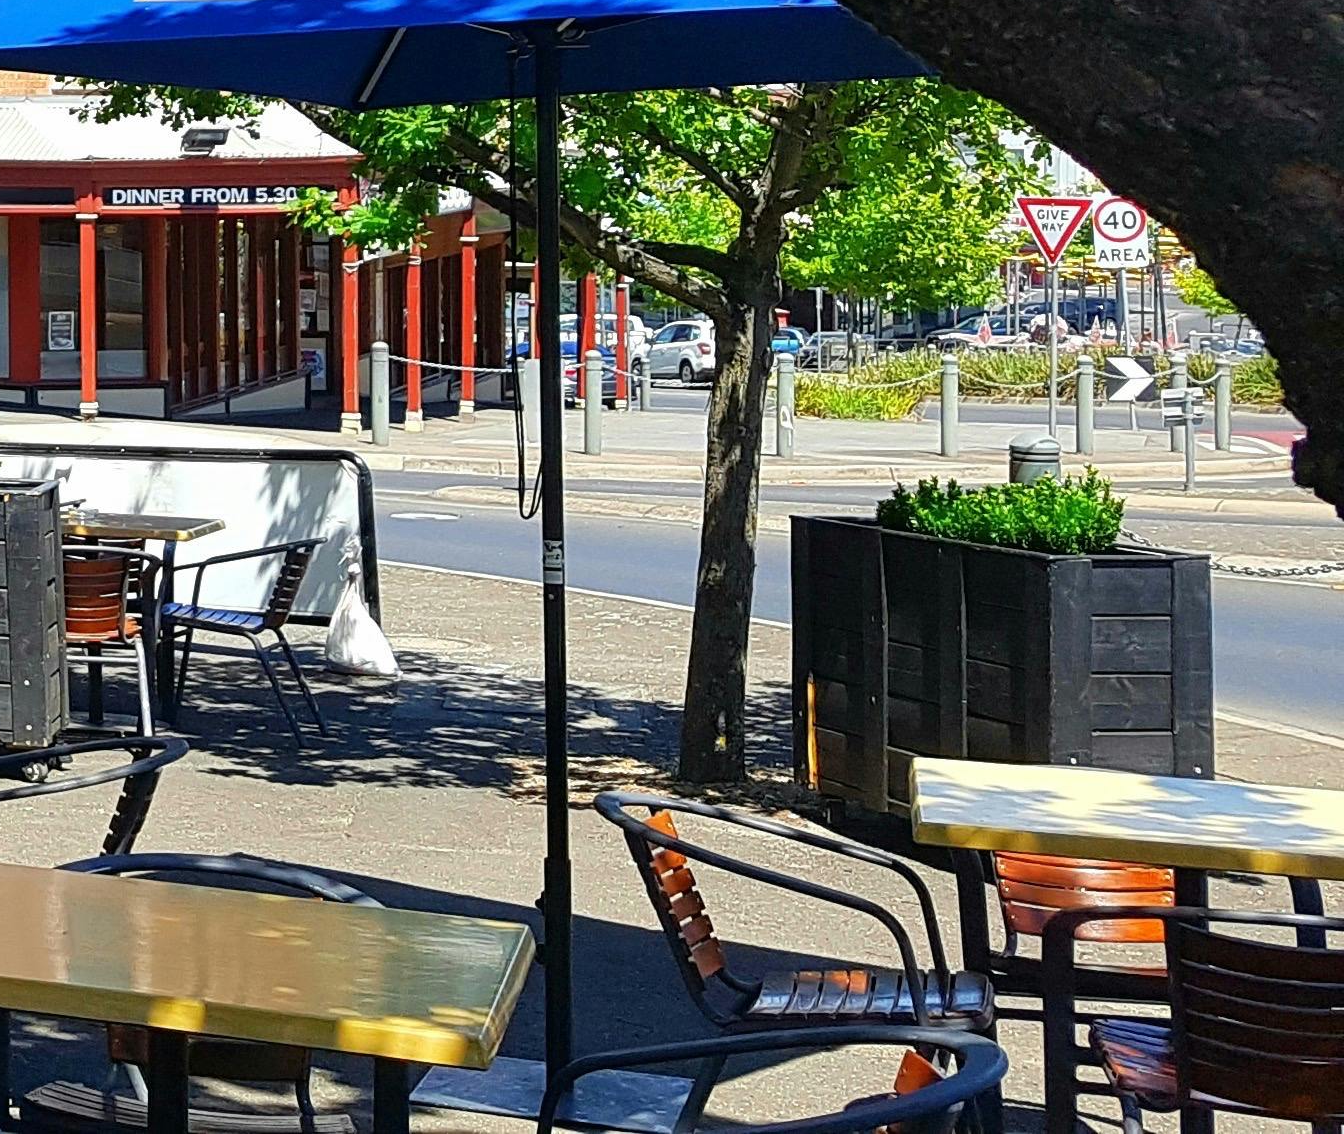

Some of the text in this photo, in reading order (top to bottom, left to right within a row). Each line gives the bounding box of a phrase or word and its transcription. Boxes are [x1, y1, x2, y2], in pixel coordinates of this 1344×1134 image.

[112, 189, 185, 205] DINNER
[191, 187, 249, 204] FROM
[1037, 209, 1070, 221] GIVE
[1103, 210, 1137, 230] 40
[1041, 222, 1065, 232] WAY
[1098, 248, 1147, 262] AREA
